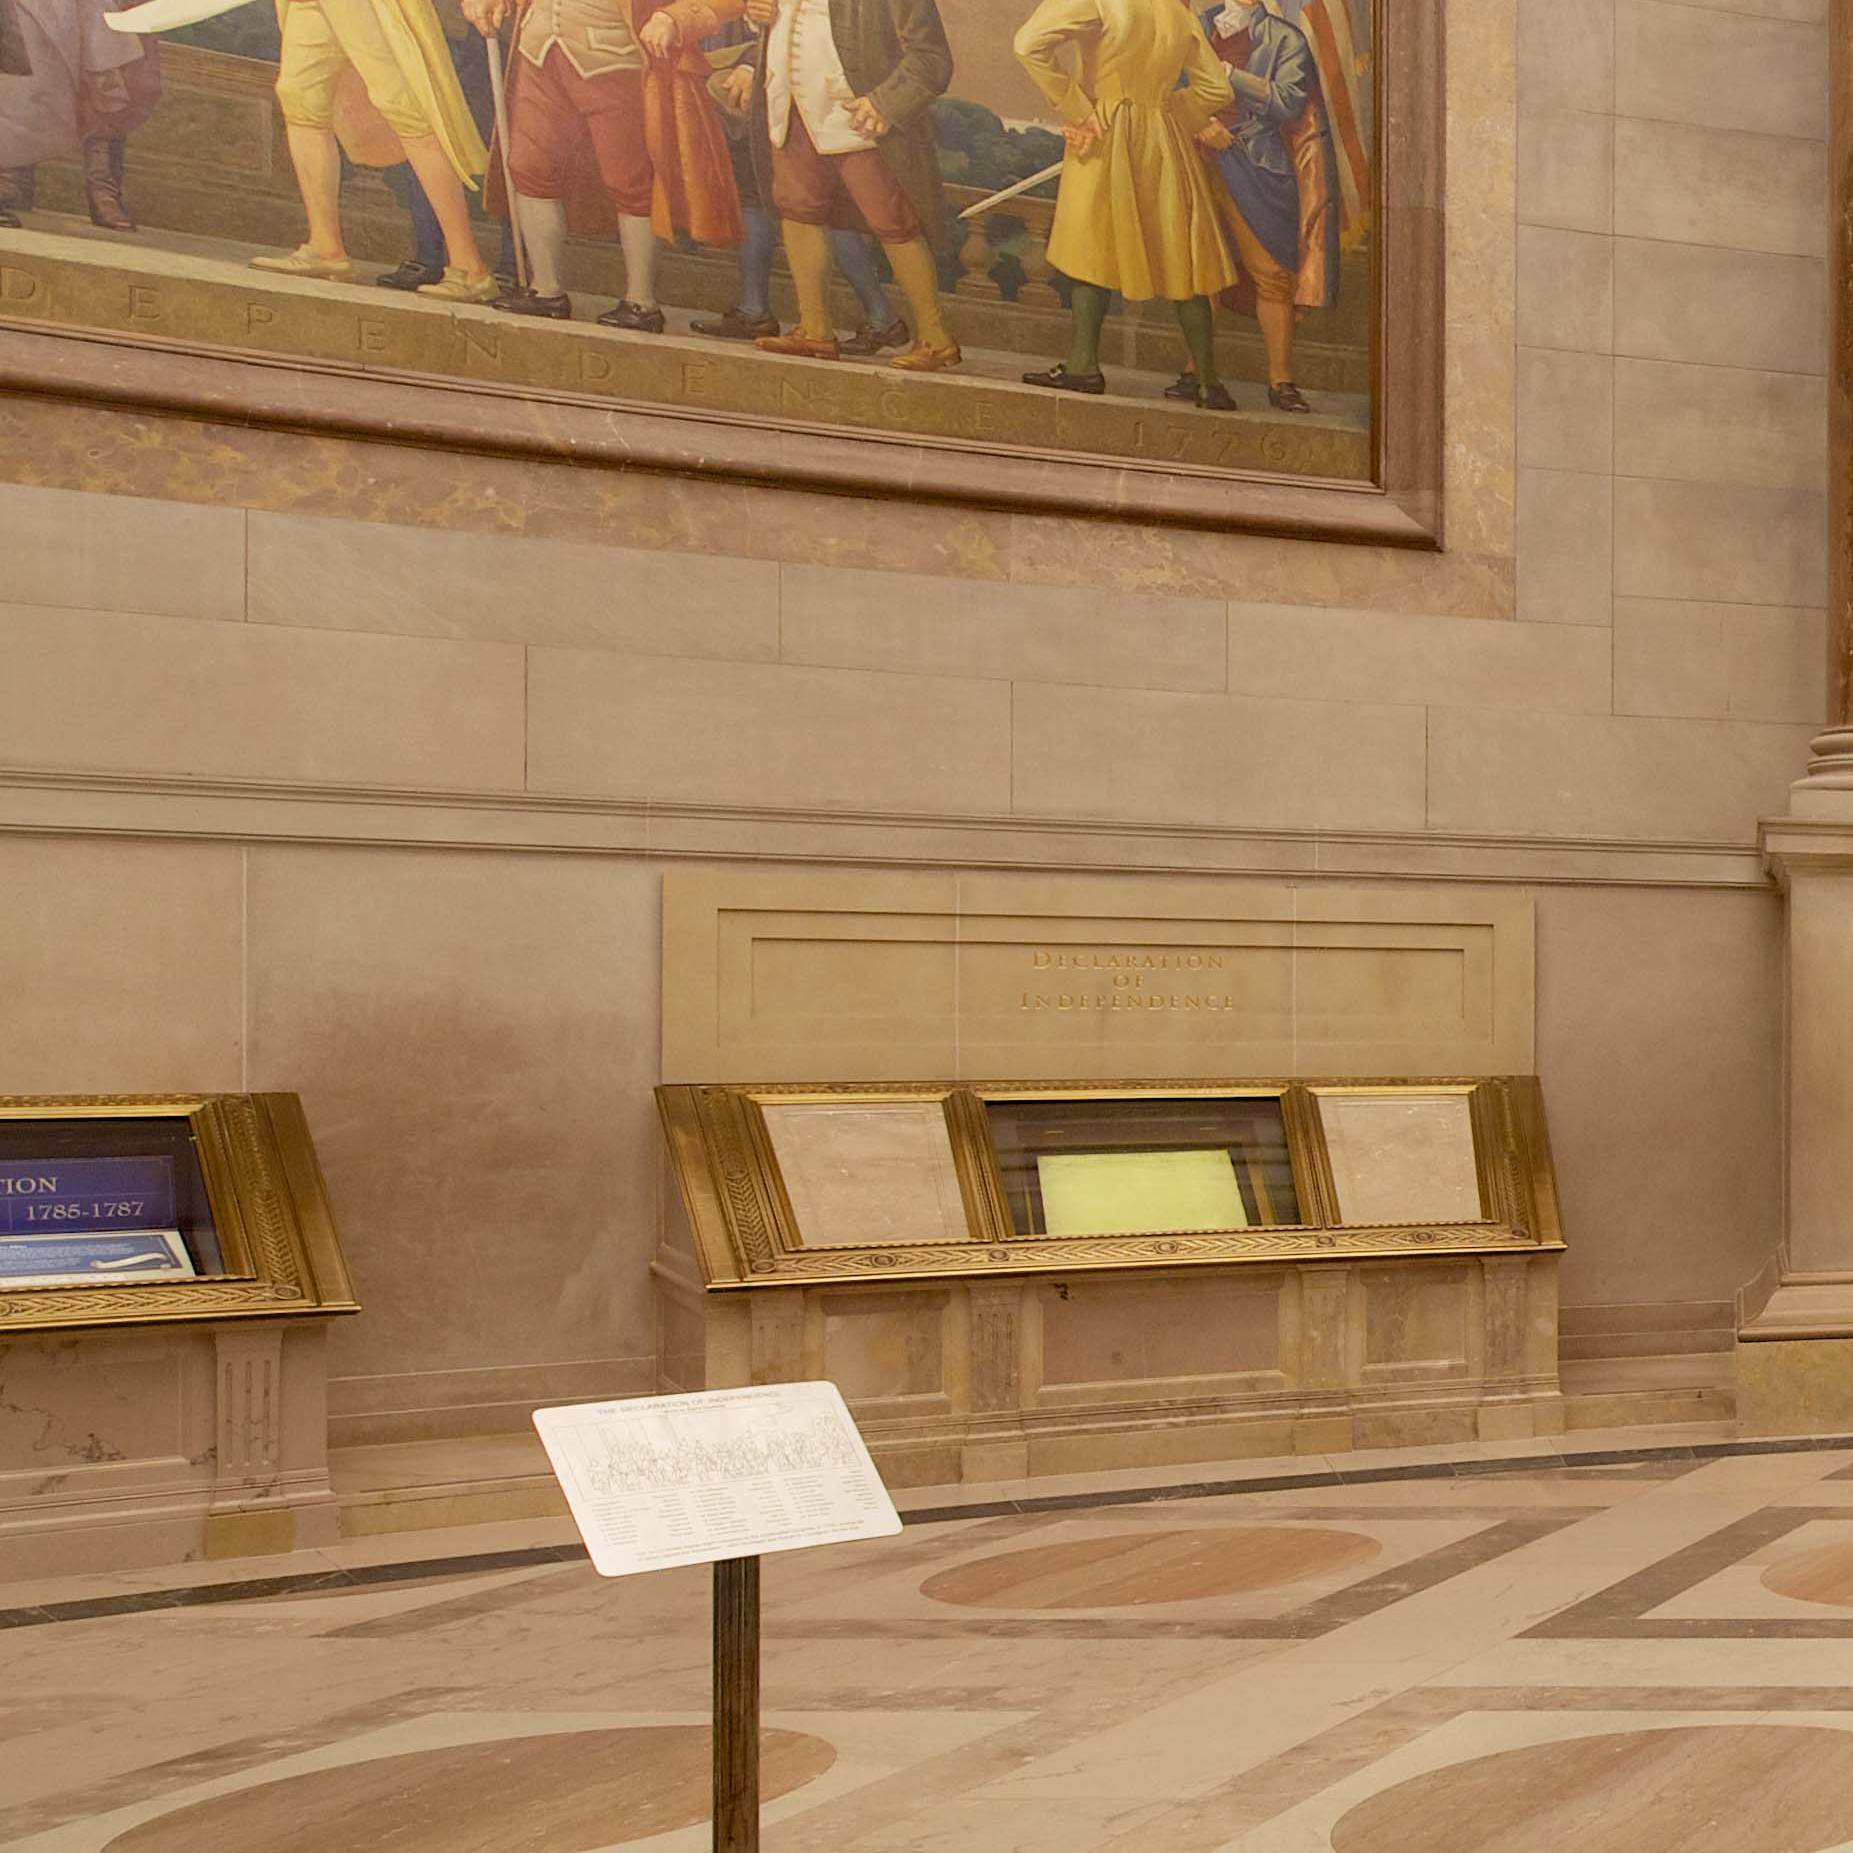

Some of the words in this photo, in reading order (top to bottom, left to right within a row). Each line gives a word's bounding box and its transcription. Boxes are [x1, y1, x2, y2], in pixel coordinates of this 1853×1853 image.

[1132, 419, 1289, 461] 1776
[1033, 951, 1224, 970] DECLARATION
[1113, 974, 1146, 990] OF
[1020, 992, 1234, 1010] INDEPENDENCE
[0, 1177, 58, 1195] ION
